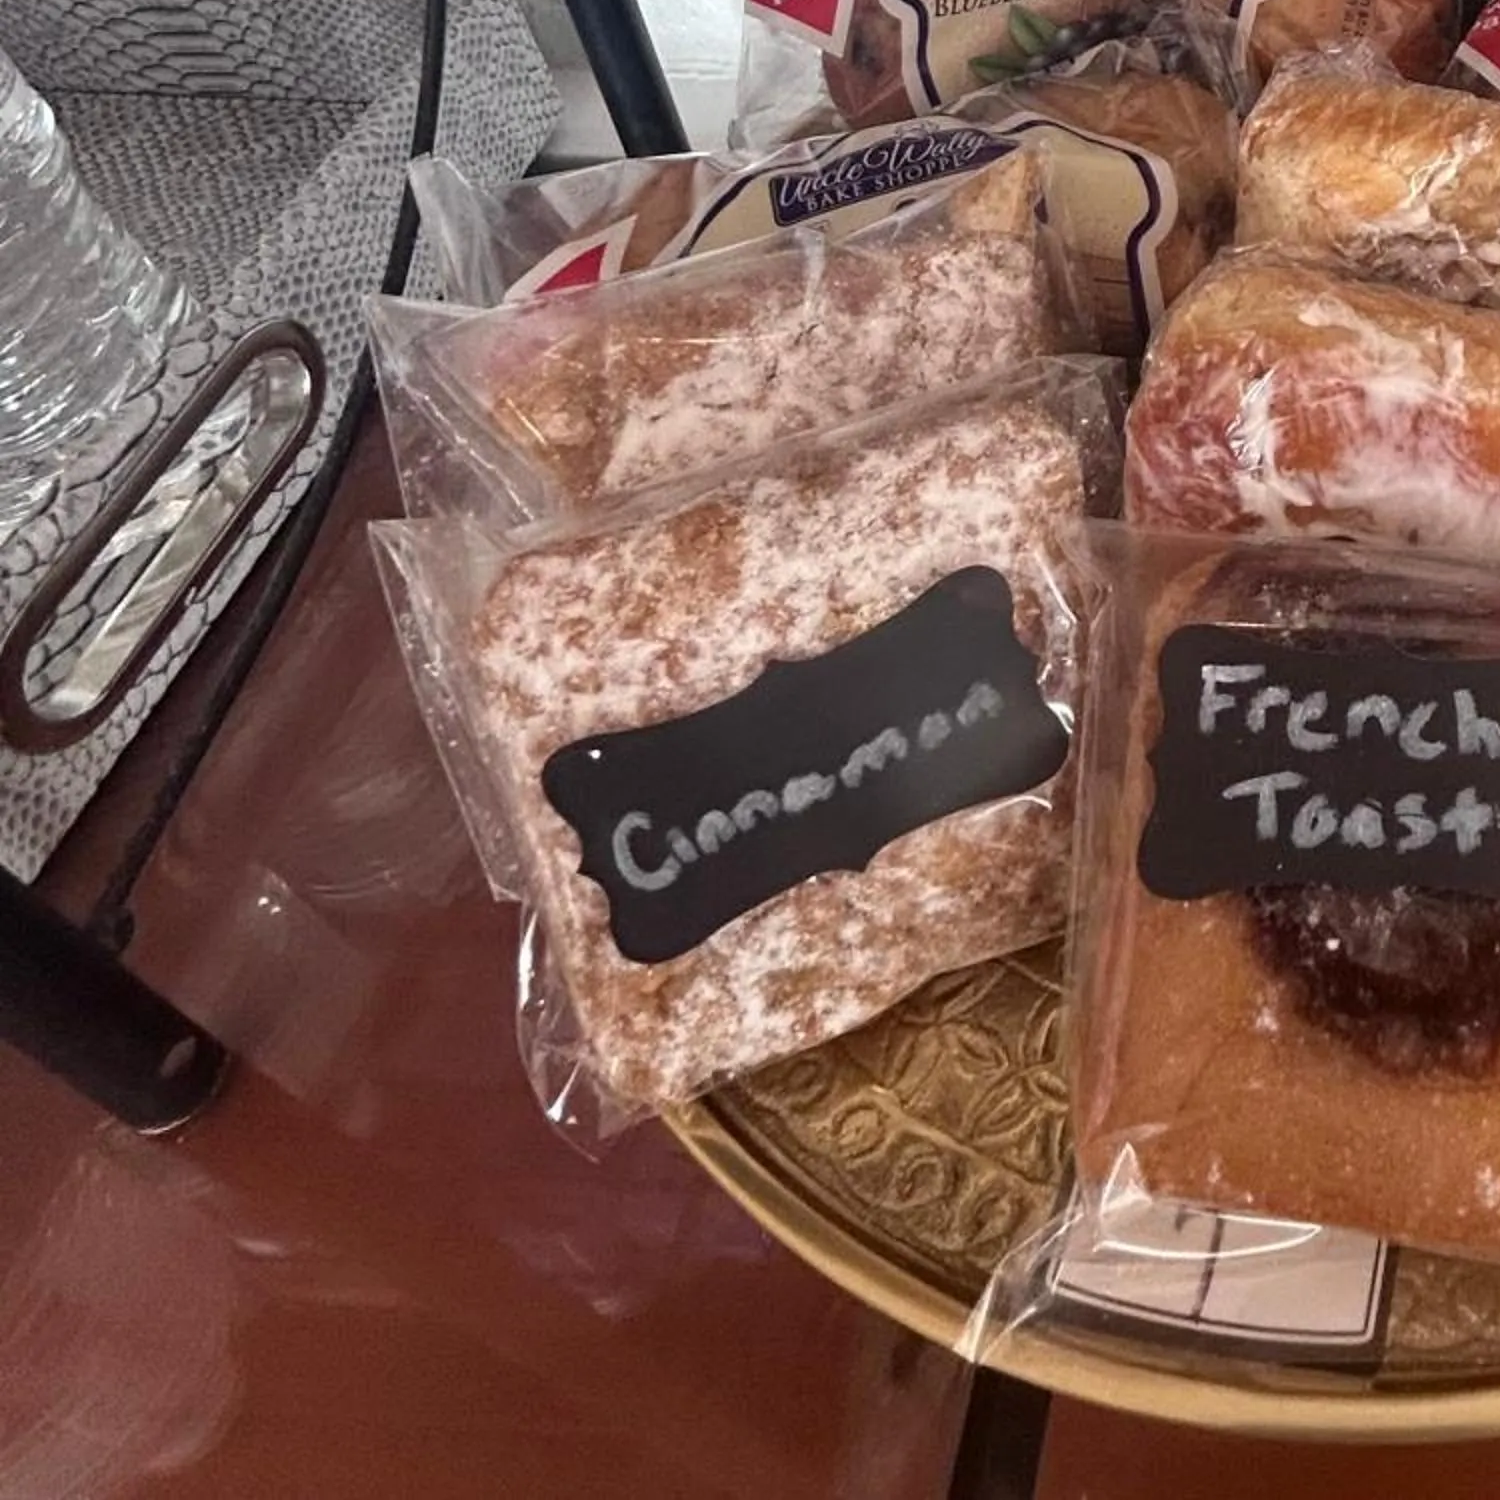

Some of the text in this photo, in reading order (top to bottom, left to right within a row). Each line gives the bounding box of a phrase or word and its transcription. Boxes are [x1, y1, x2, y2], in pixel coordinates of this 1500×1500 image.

[781, 158, 865, 207] Uncle
[806, 180, 864, 212] BAKE
[611, 679, 1003, 892] Cinnamon
[1222, 770, 1498, 854] Toast
